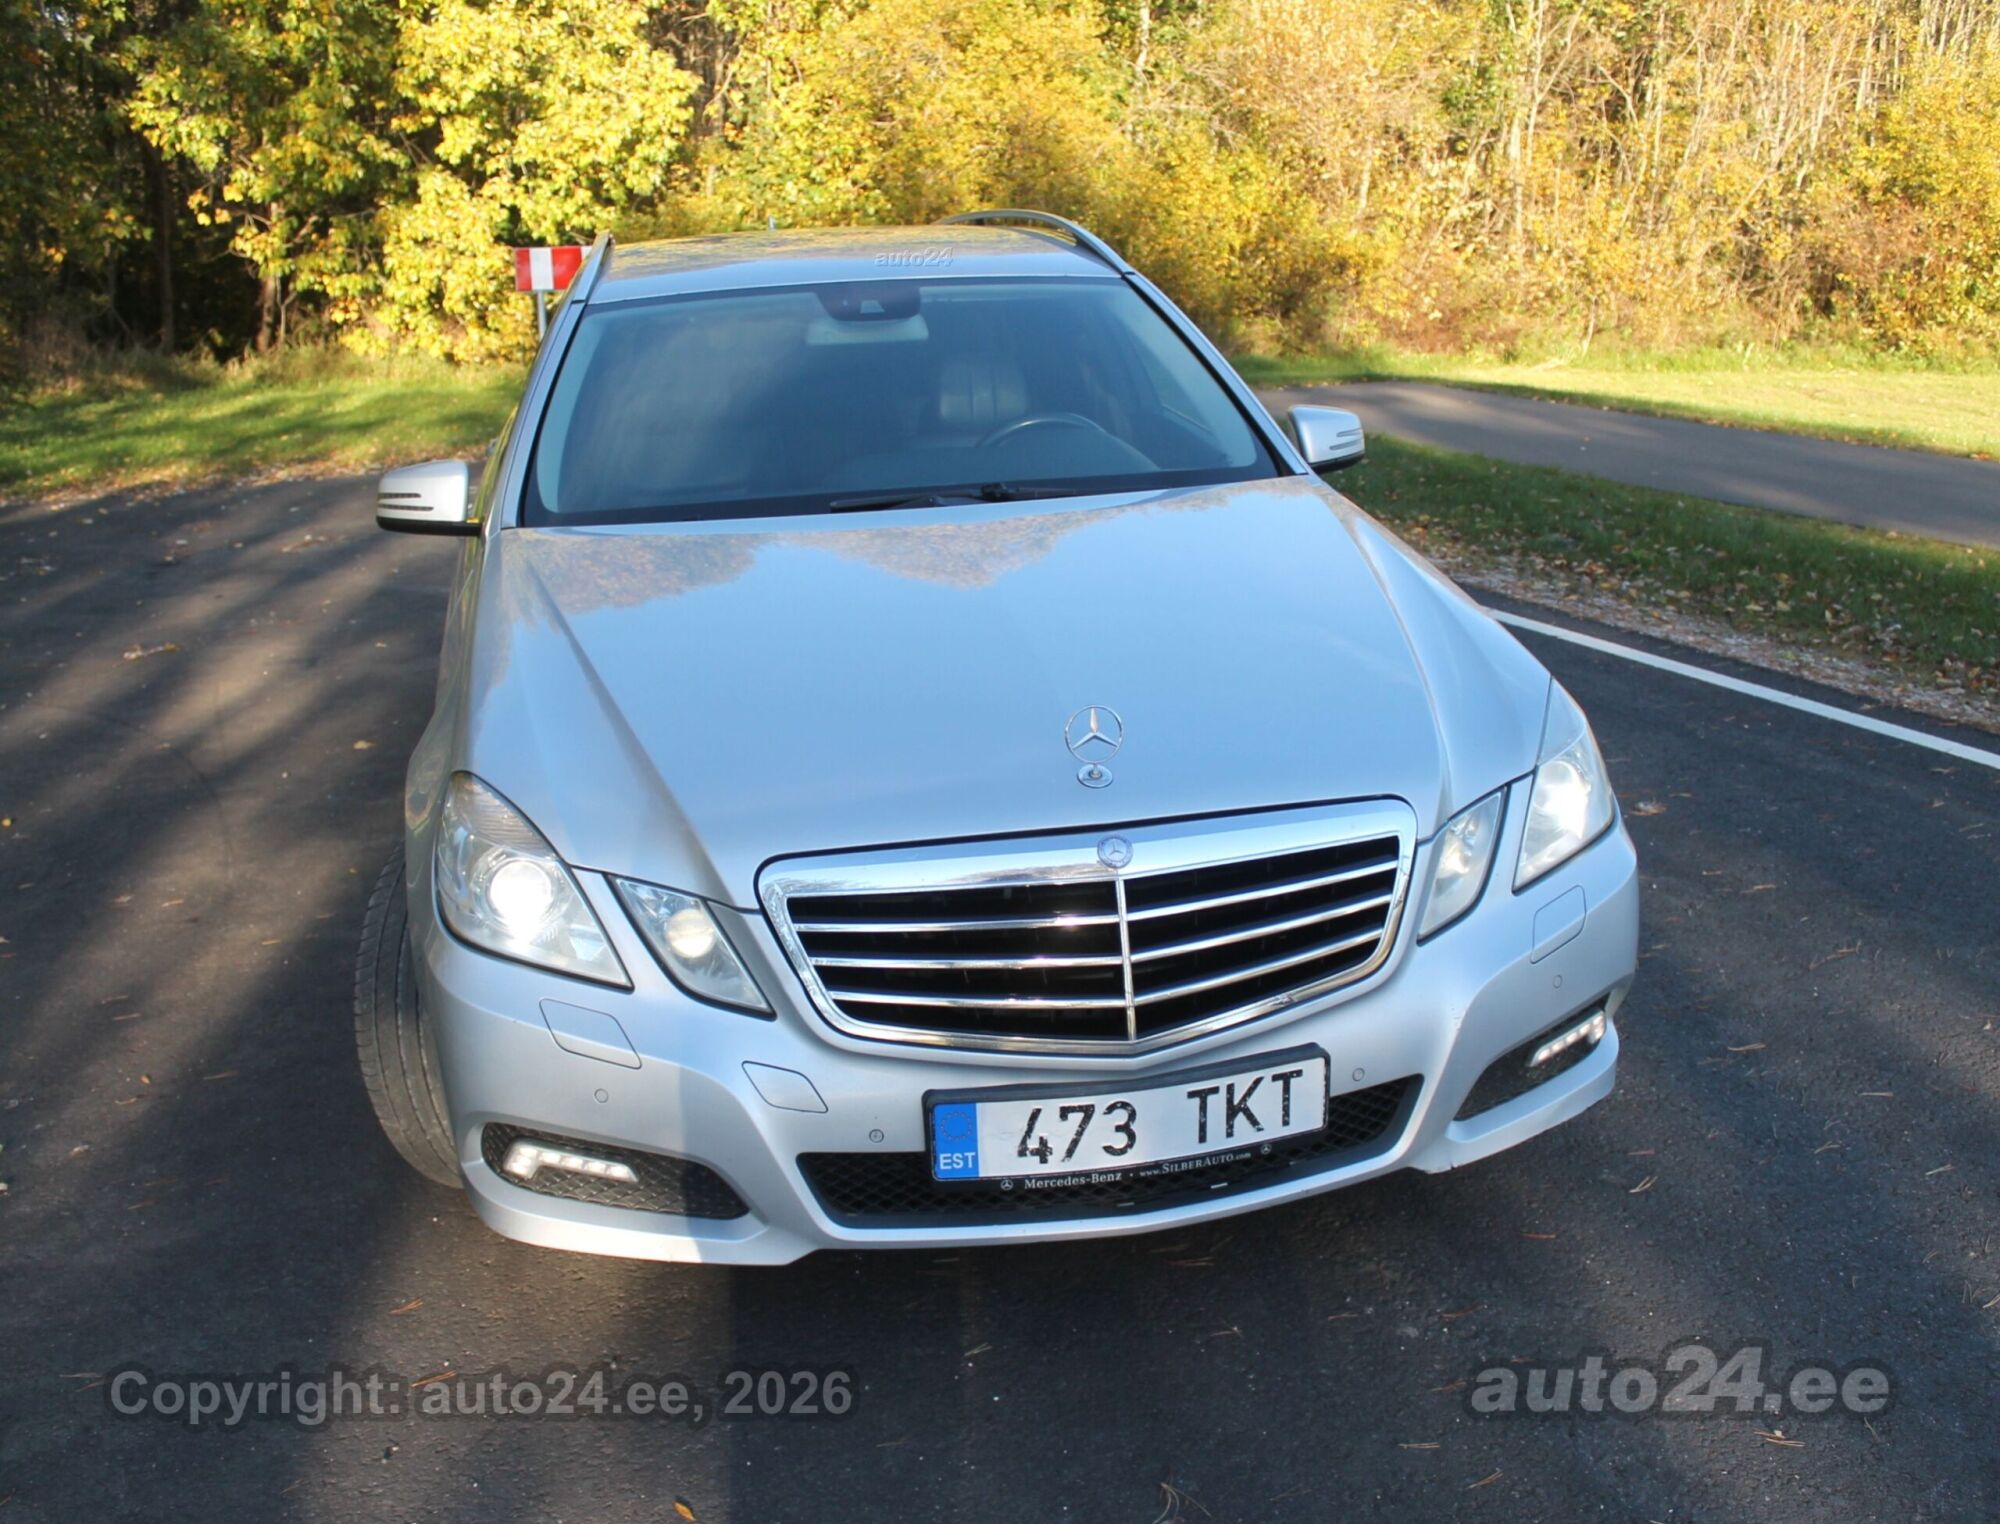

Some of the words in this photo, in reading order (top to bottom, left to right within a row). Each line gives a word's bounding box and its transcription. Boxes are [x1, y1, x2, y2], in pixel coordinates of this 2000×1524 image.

[1017, 1100, 1137, 1165] 473
[1186, 1068, 1303, 1145] TKT
[939, 1151, 976, 1170] EST
[1024, 1171, 1123, 1190] Mercedes-Benz
